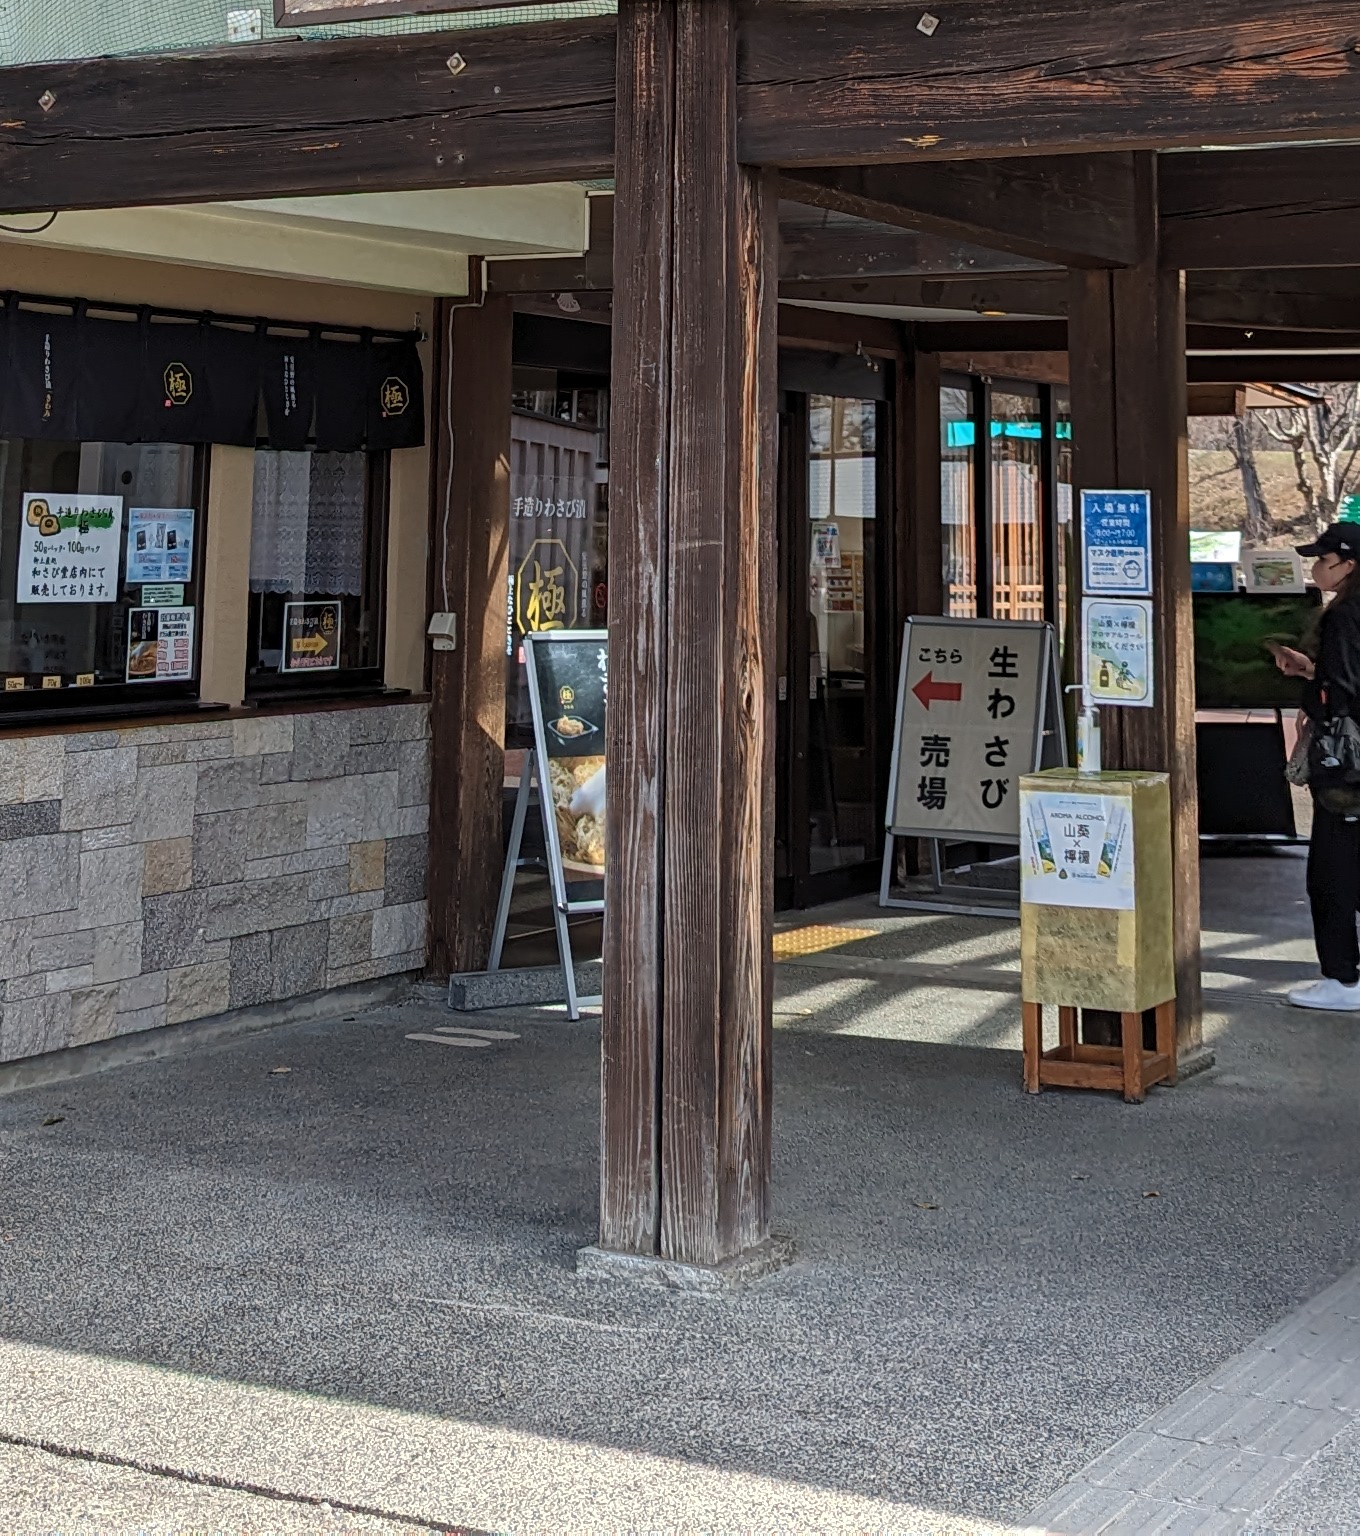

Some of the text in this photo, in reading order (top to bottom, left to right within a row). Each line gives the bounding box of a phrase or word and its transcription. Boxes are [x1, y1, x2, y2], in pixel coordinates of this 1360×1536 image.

[168, 370, 187, 397] 極
[385, 385, 403, 409] 極
[513, 497, 586, 518] 手造りわさび漬
[1091, 502, 1140, 514] 入場無料
[30, 583, 108, 597] 販売しております。
[527, 560, 565, 631] 極
[1092, 631, 1143, 639] アロマアルコール
[918, 647, 963, 664] こちら
[1091, 642, 1144, 651] お試しください
[980, 646, 1019, 809] 生わさび
[916, 734, 951, 810] 売場
